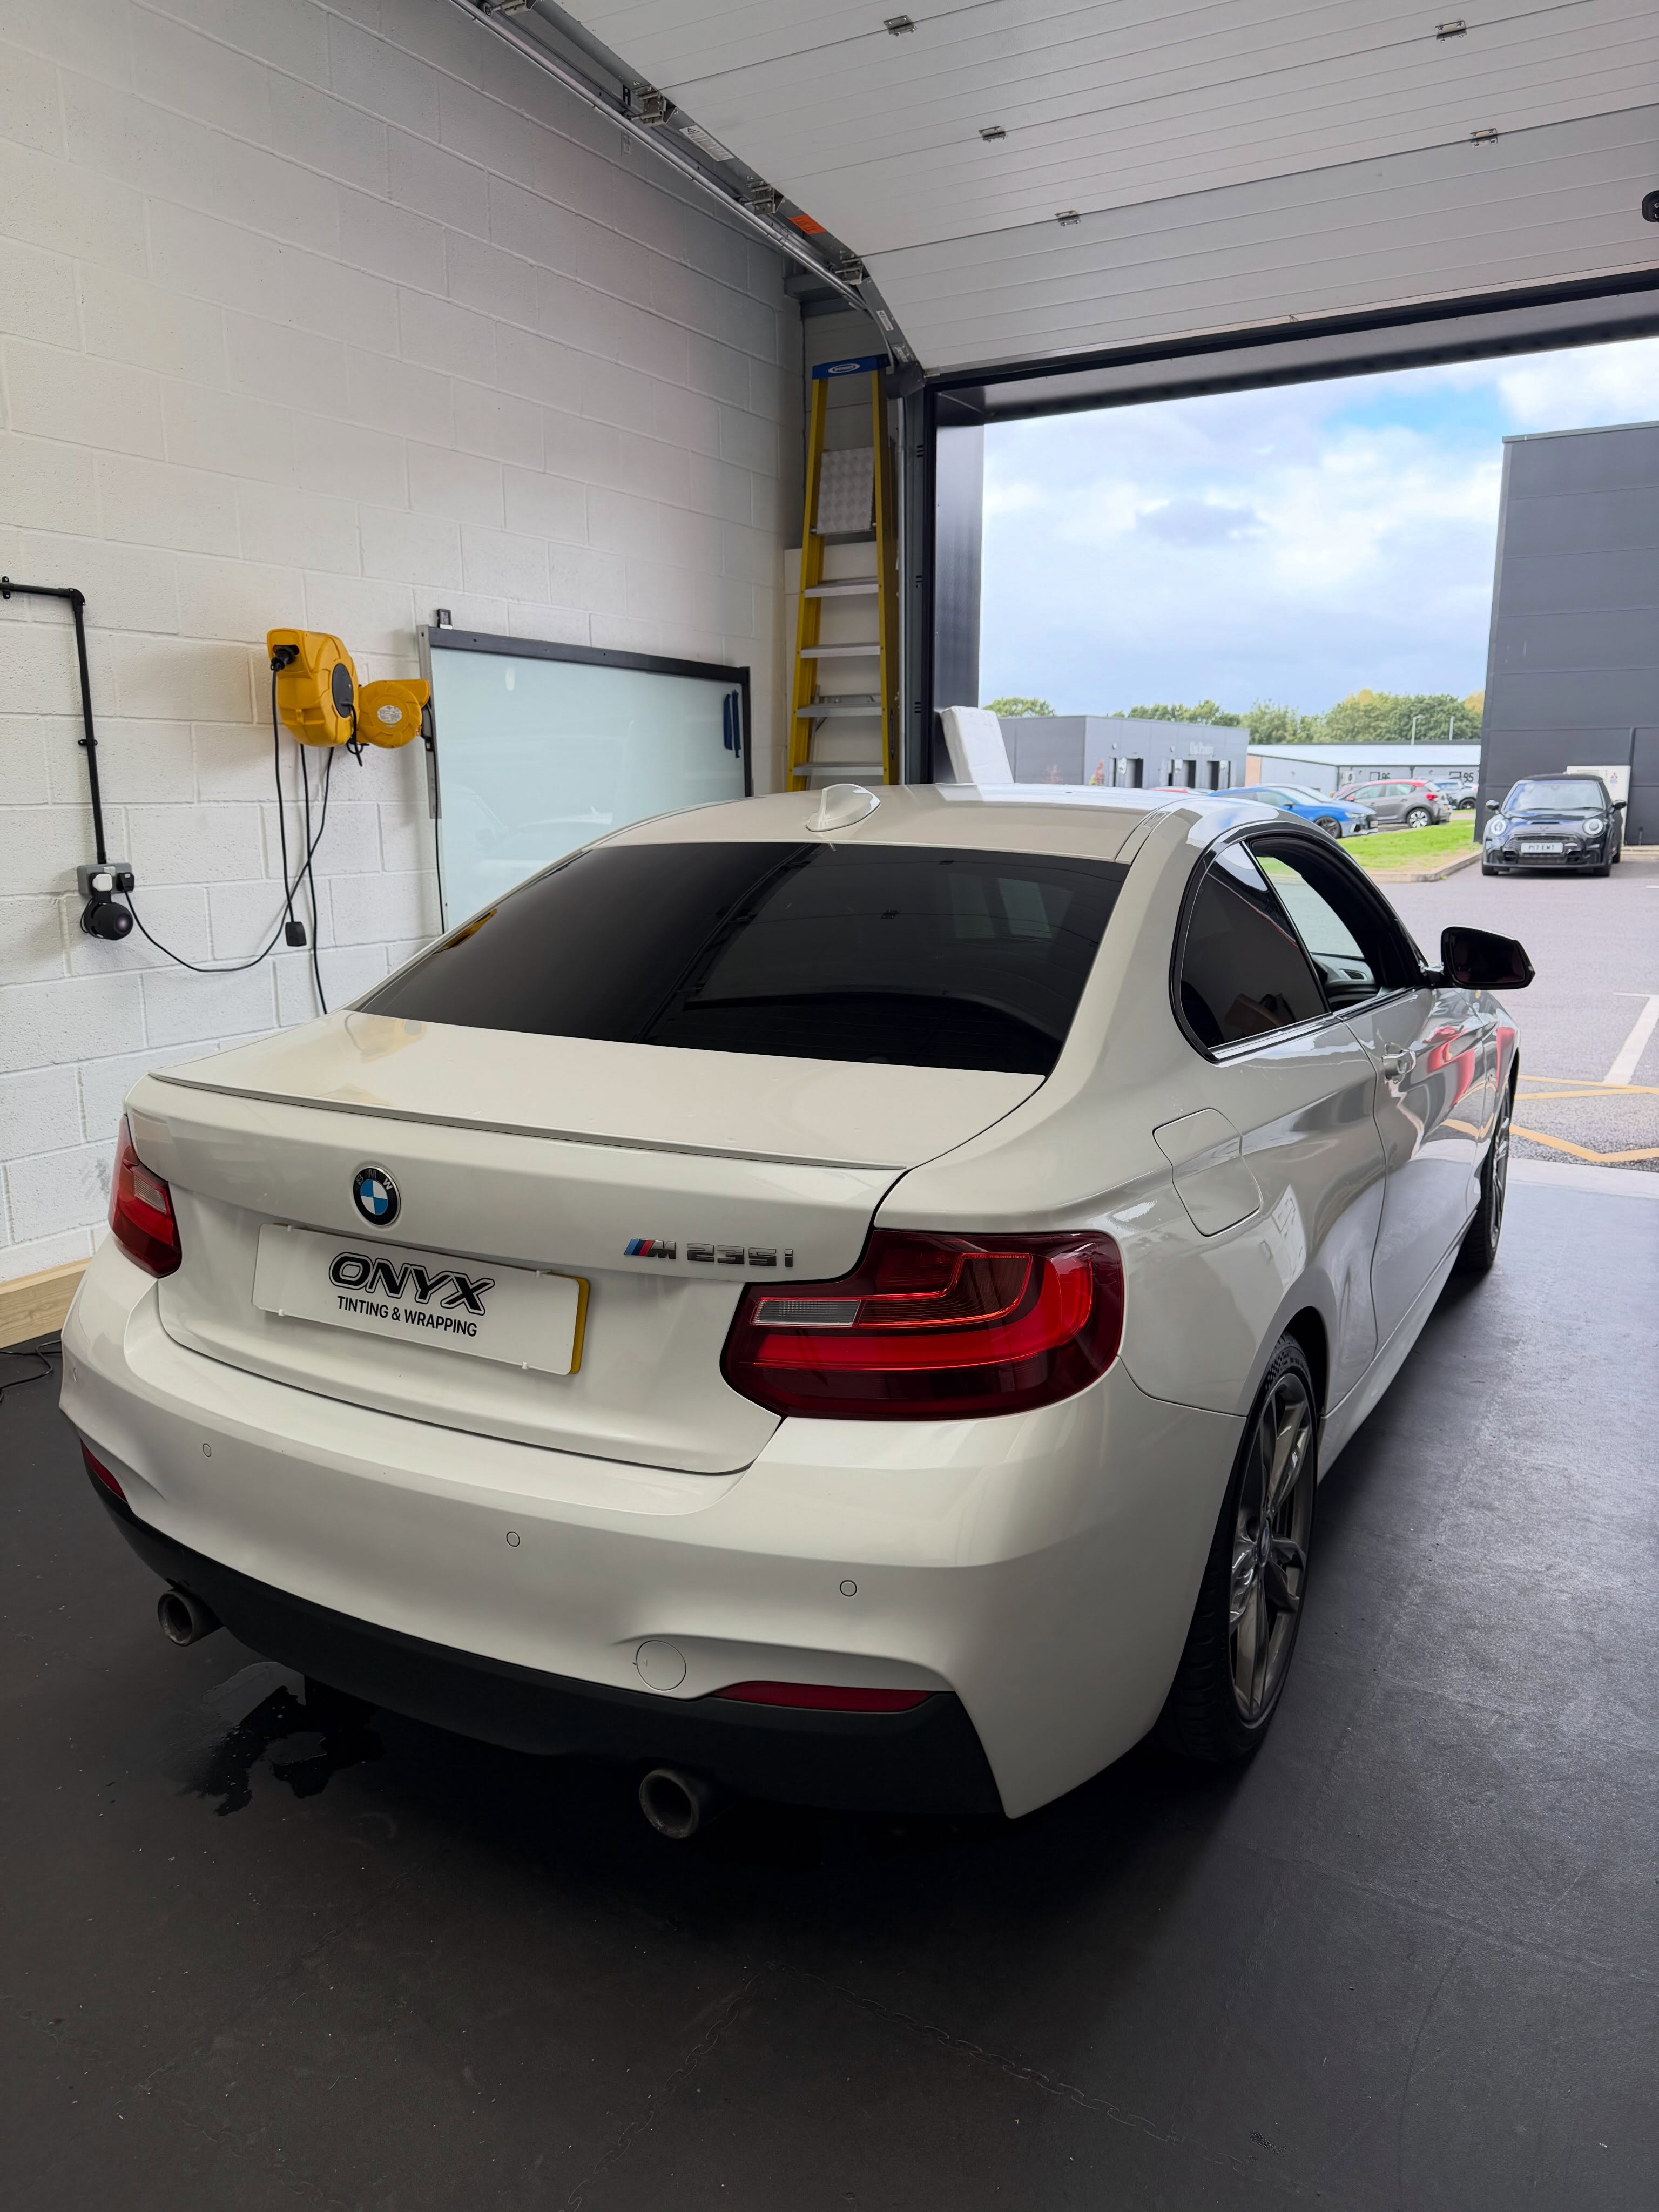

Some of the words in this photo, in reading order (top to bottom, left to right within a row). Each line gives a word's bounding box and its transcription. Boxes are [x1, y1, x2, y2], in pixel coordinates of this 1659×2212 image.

[356, 1169, 393, 1190] BMW
[328, 1251, 495, 1316] ONYX
[337, 1296, 389, 1319] TINTING
[391, 1309, 401, 1321] &
[404, 1311, 477, 1337] WRAPPING
